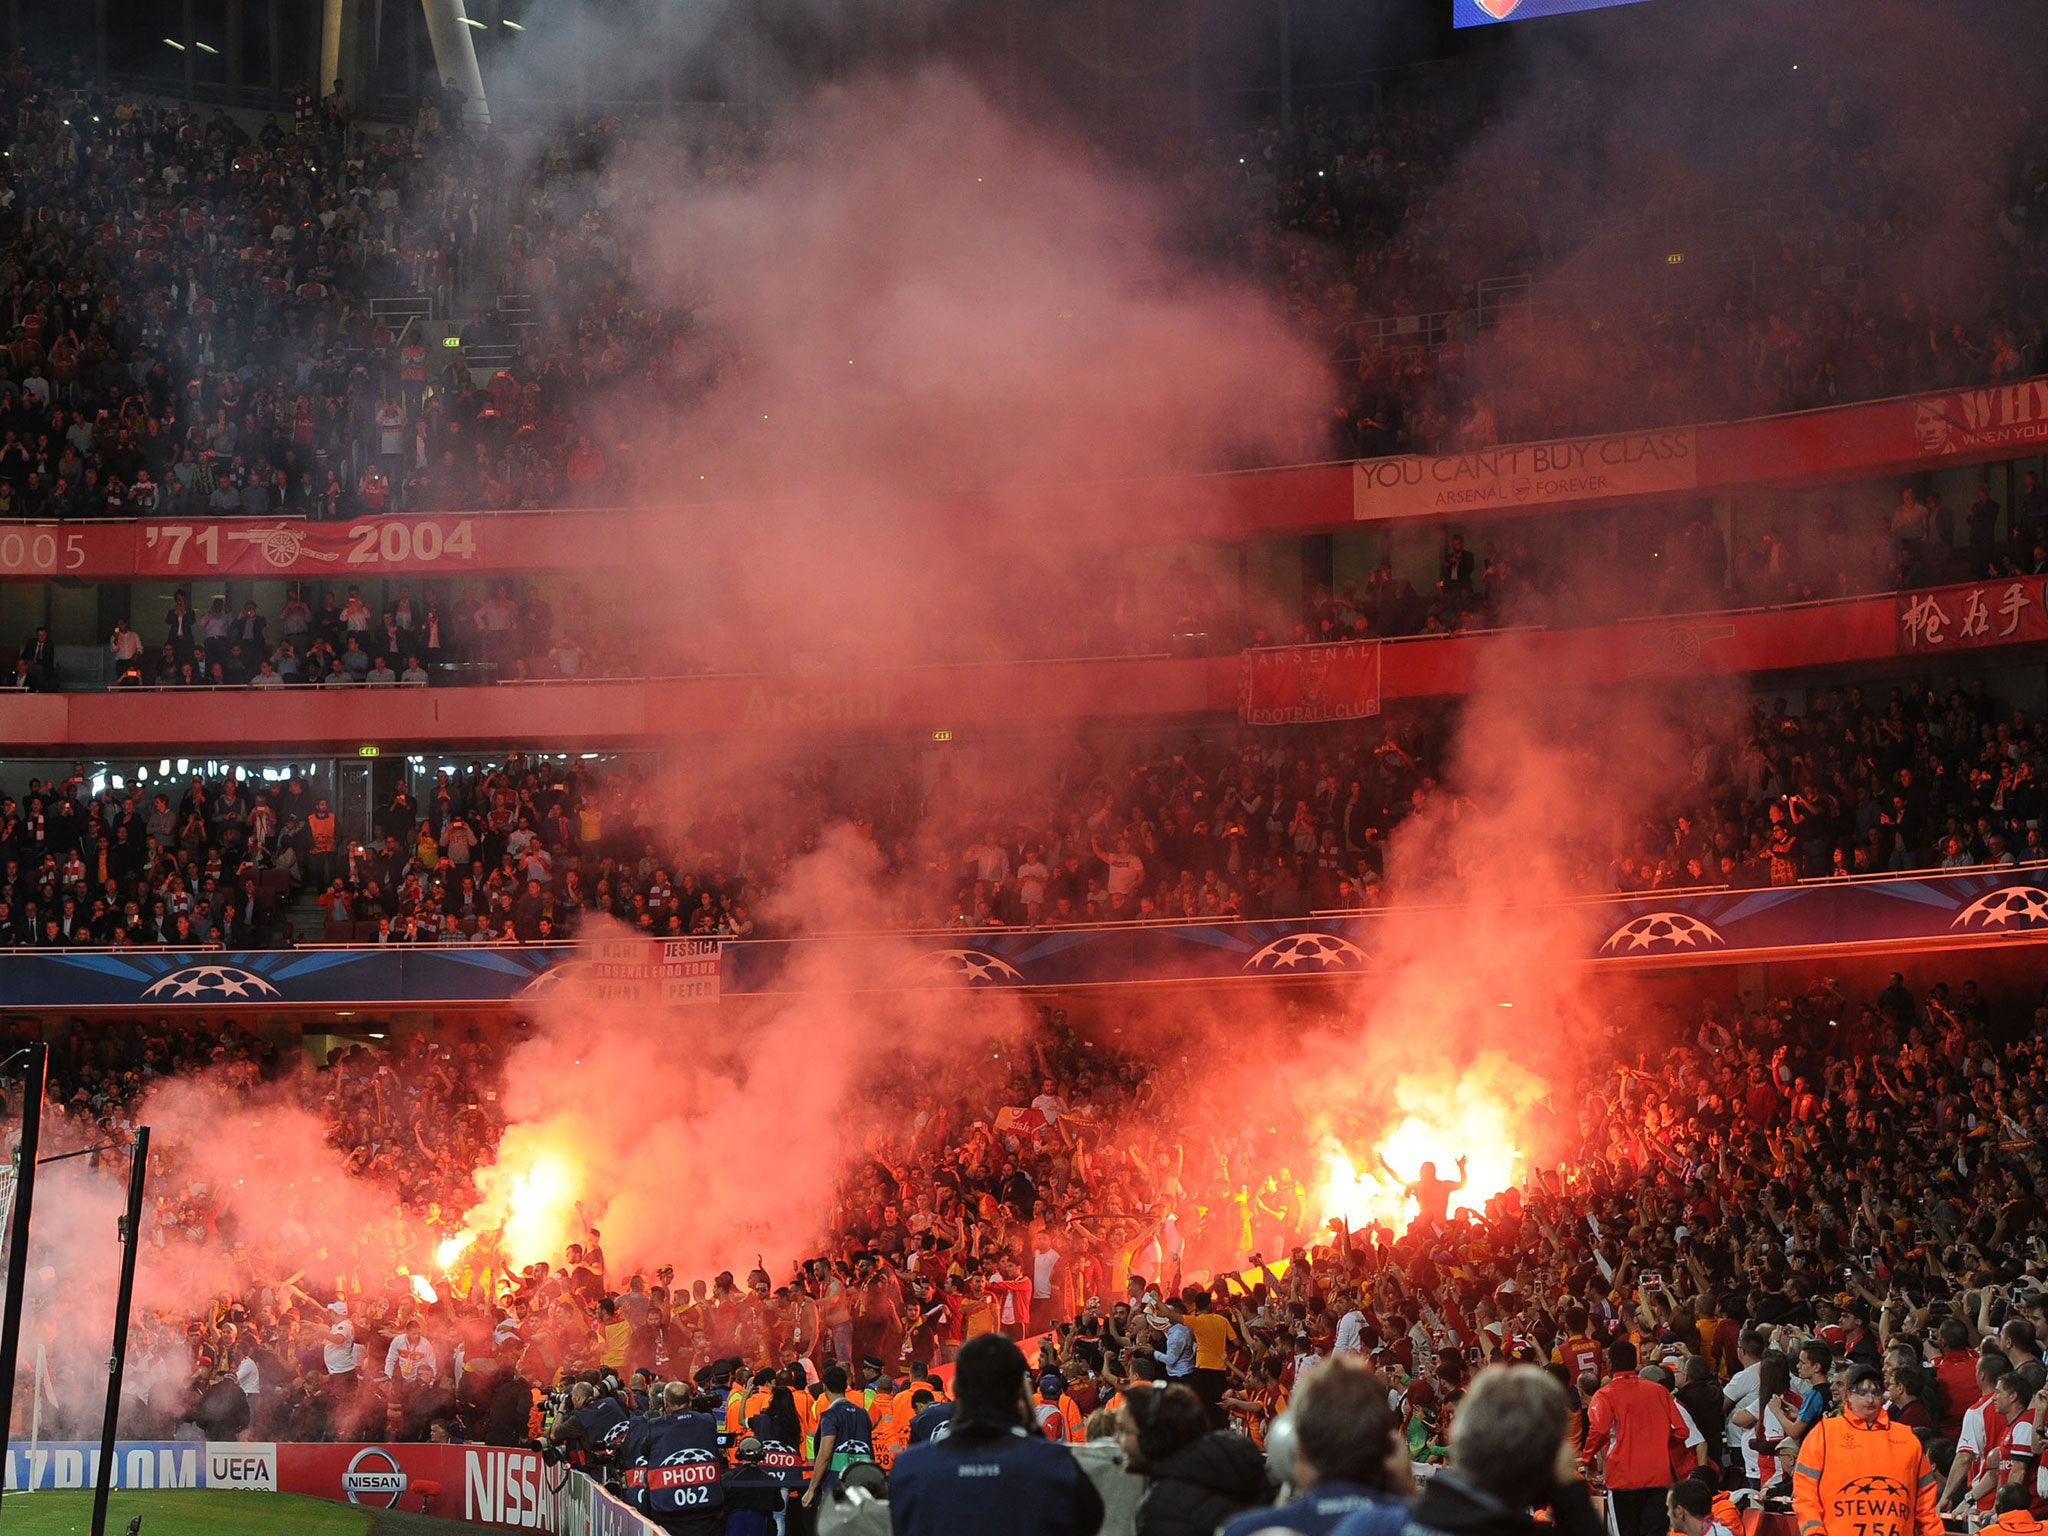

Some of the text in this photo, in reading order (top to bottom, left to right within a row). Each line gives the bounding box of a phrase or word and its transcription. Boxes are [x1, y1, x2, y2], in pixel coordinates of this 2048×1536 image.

[1360, 433, 1689, 490] YOU CAN'T BUY CLASS
[1435, 475, 1608, 506] ARSENAL FOREVER
[347, 520, 477, 563] 2004
[1257, 645, 1371, 667] ARSENAL
[742, 685, 890, 725] Arsenal
[1252, 698, 1378, 723] FOOTBALL CLUB
[665, 941, 719, 957] JESSICA
[596, 962, 716, 978] ARSENAL EURO TOUR
[668, 982, 713, 998] PETER
[213, 1457, 270, 1481] UEFA
[760, 1453, 795, 1467] HOTO
[347, 1475, 402, 1489] NISSAN
[662, 1465, 716, 1486] PHOTO
[673, 1485, 710, 1506] 062
